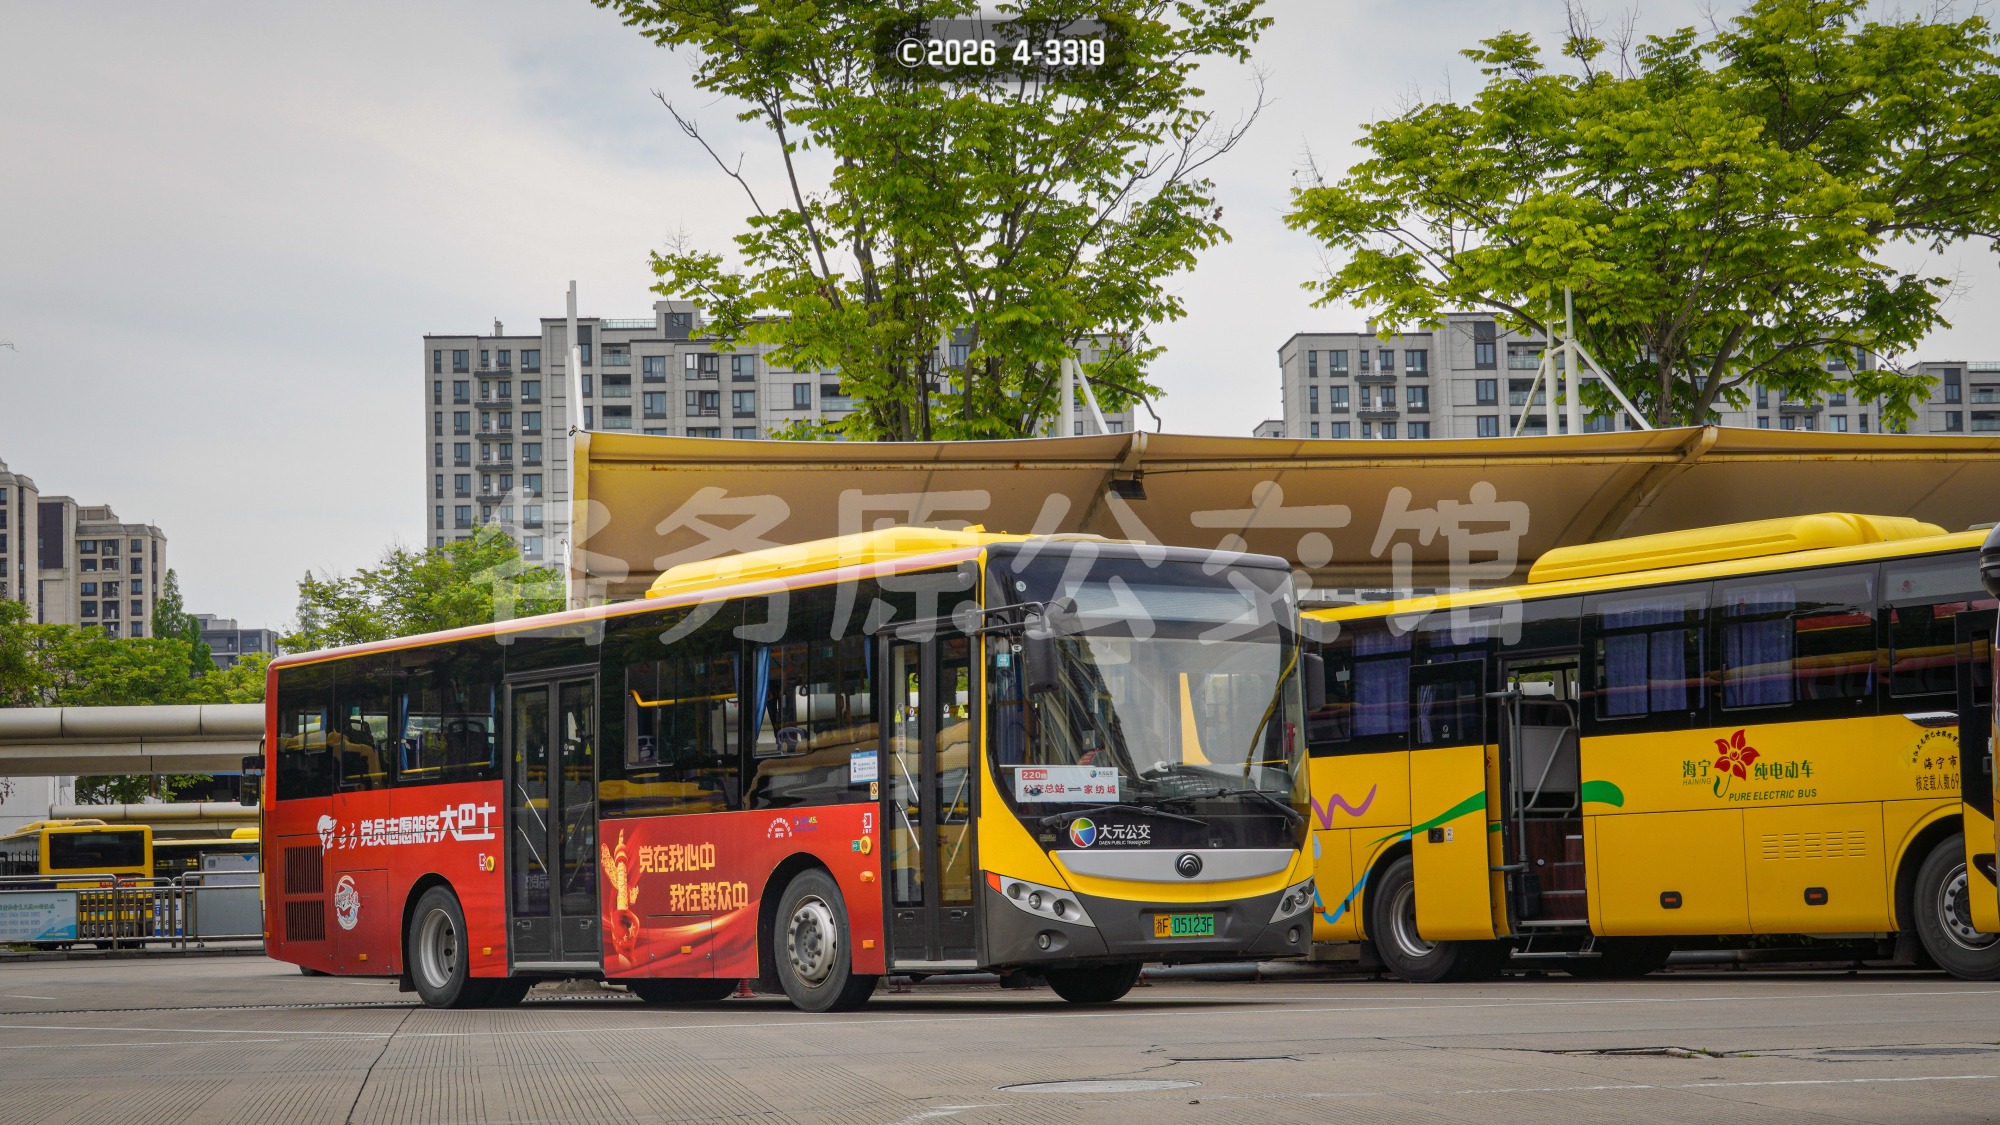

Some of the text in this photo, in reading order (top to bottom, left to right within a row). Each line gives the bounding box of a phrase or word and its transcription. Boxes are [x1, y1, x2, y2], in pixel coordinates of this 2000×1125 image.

[1683, 760, 1711, 778] 海宁
[1754, 760, 1814, 780] 纯电动车
[1924, 755, 1957, 770] 海宁市
[1084, 785, 1116, 794] 家纺城
[1683, 778, 1711, 786] HAINING
[1729, 788, 1817, 801] PURE ELECTRIC BUS
[1099, 824, 1151, 840] 大元公交
[638, 842, 715, 873] 党在我心中
[669, 881, 749, 911] 我在群众中
